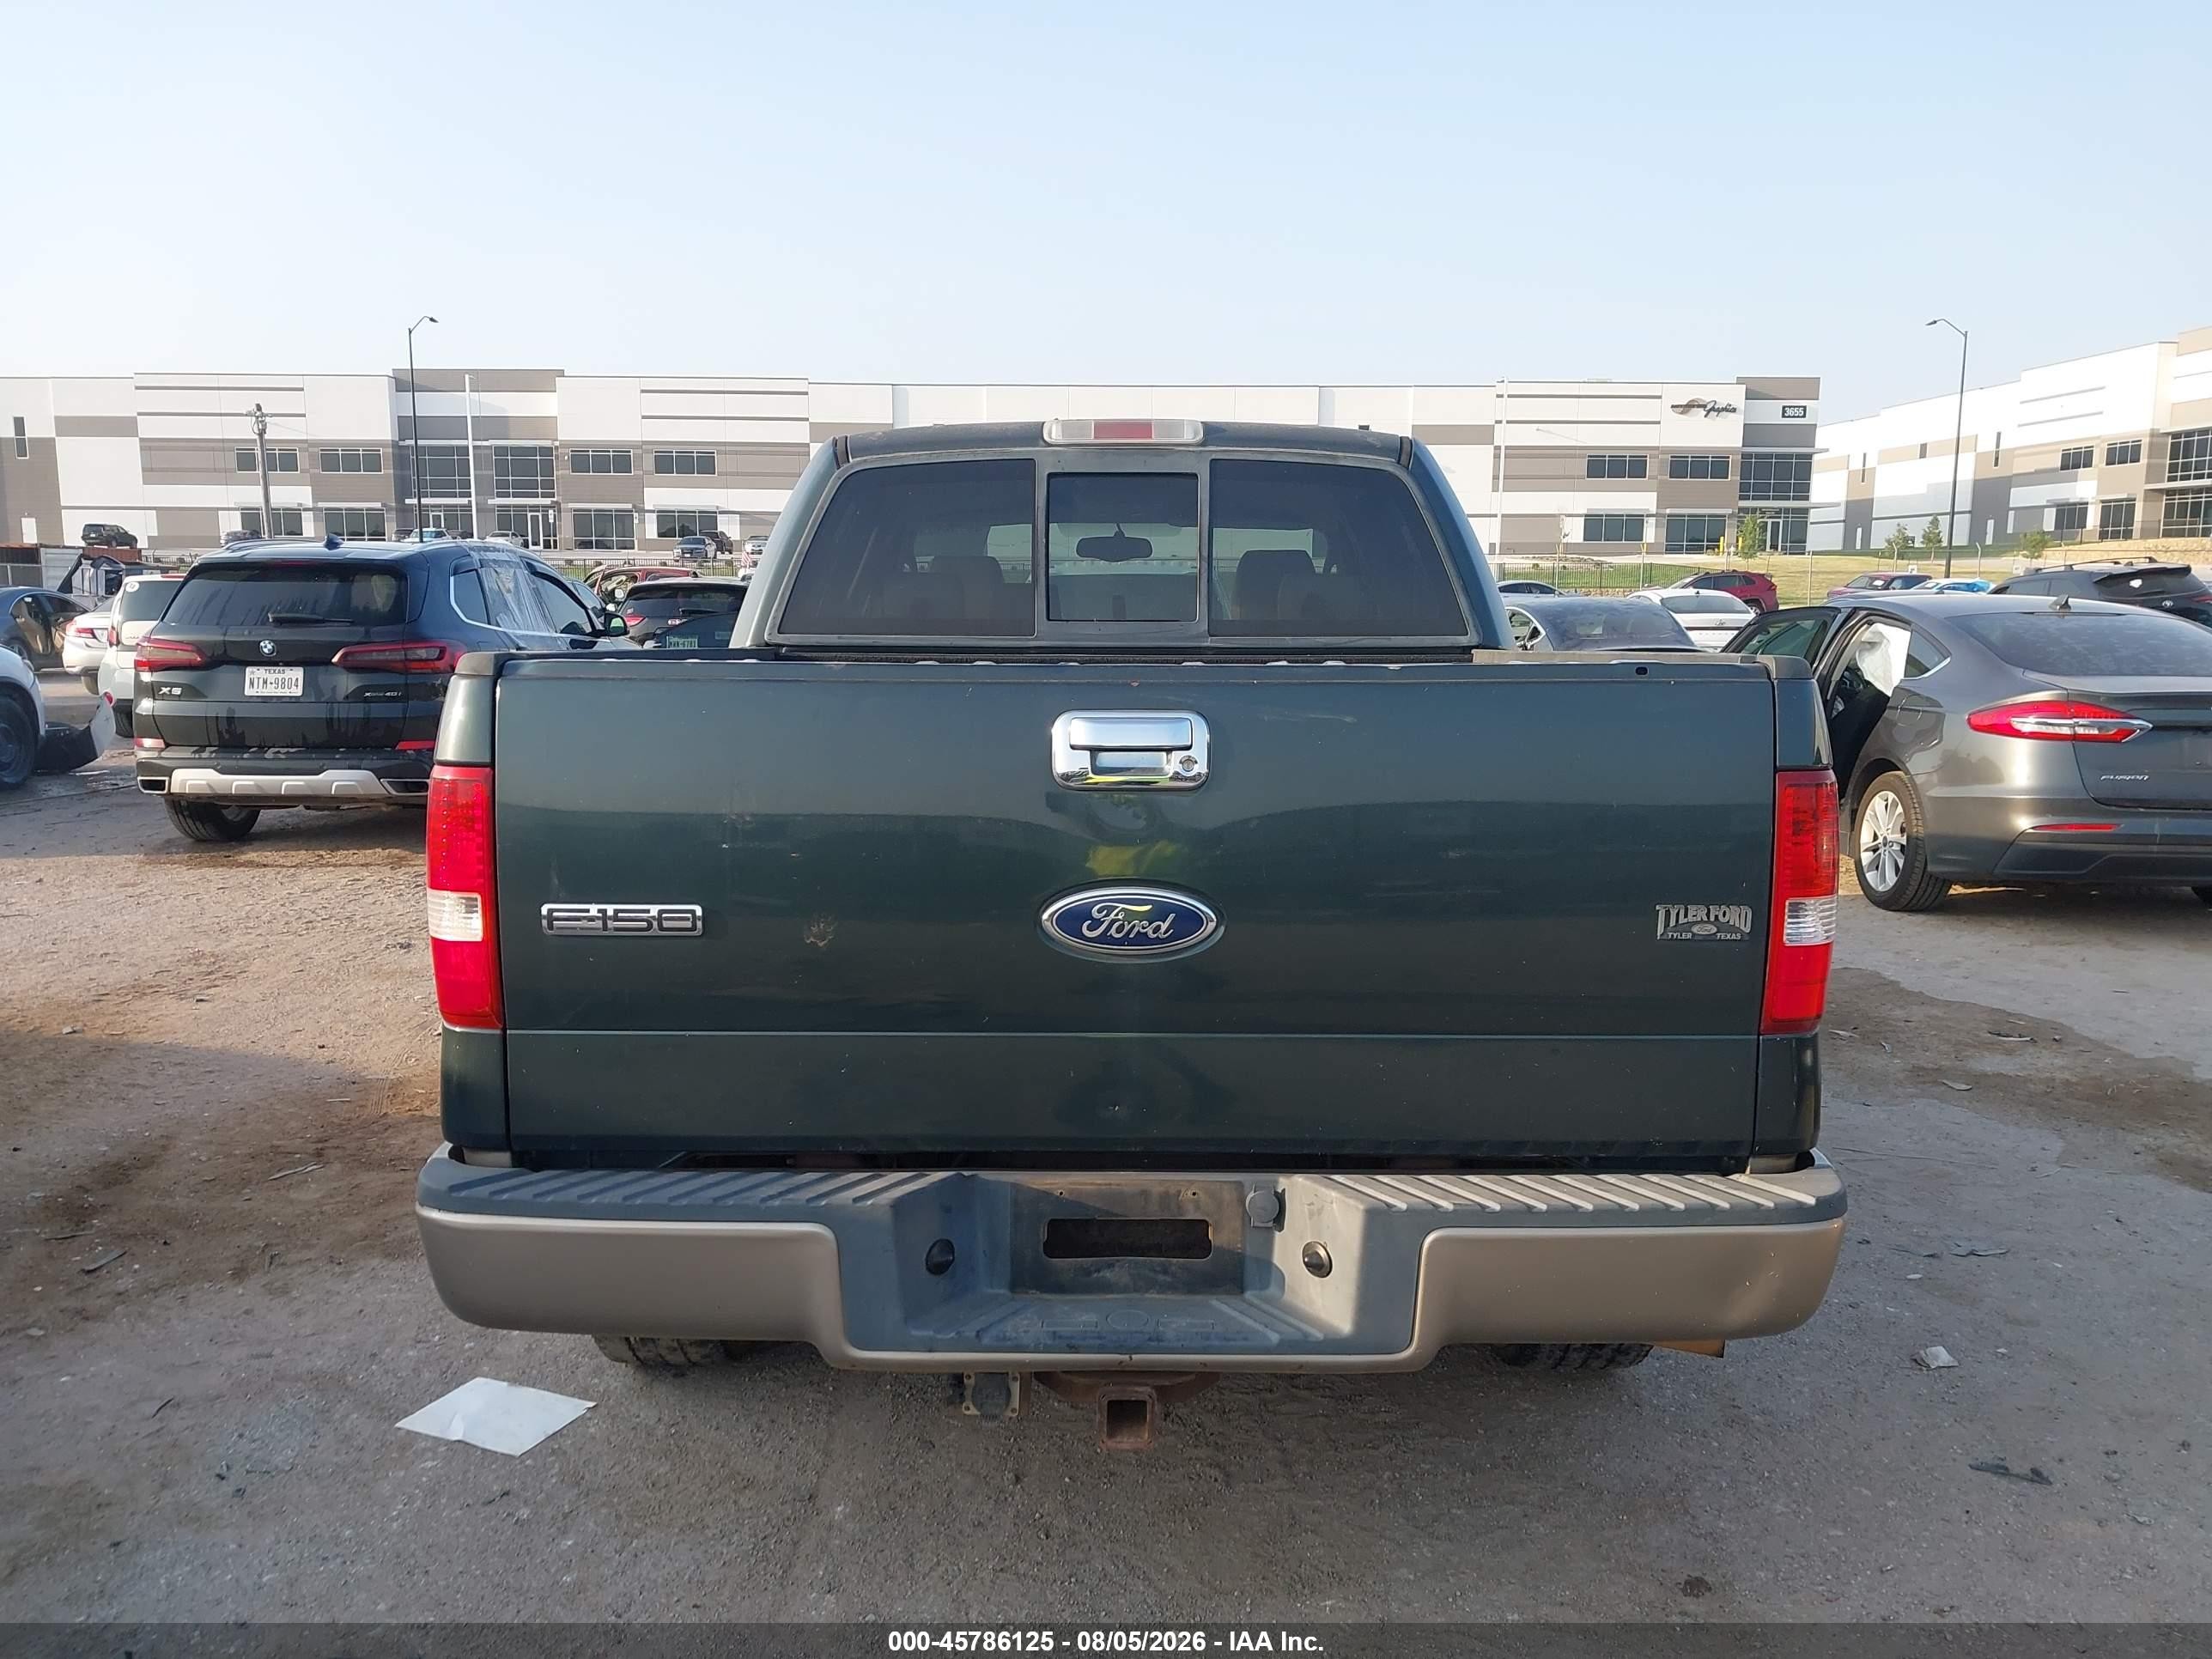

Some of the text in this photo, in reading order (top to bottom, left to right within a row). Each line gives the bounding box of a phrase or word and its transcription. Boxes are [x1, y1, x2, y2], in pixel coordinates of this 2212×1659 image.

[1784, 407, 1804, 416] 3655
[546, 908, 697, 933] F-150
[1081, 902, 1176, 939] Ford
[1656, 904, 1753, 940] TYLER FORD
